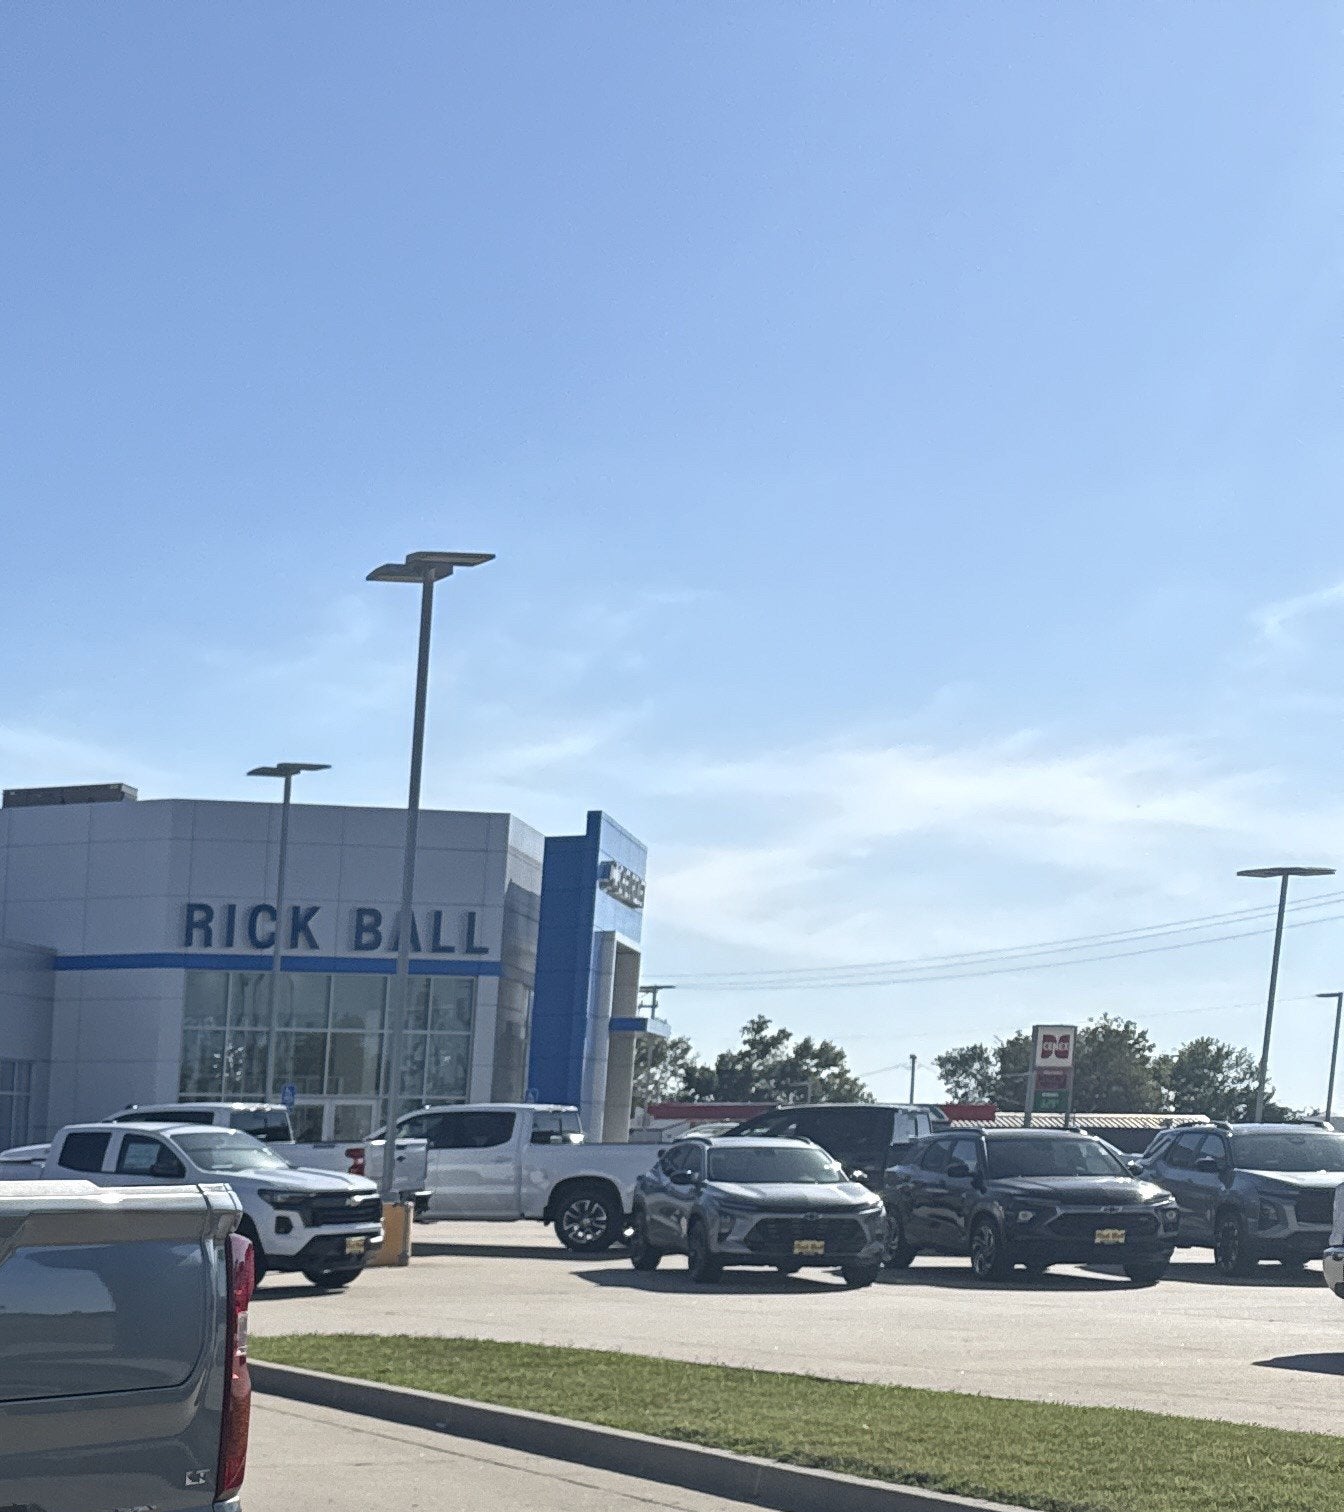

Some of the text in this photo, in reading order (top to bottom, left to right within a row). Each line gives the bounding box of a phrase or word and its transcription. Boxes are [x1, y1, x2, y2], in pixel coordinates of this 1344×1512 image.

[183, 903, 490, 955] RICK BALL
[185, 1468, 210, 1486] LT
